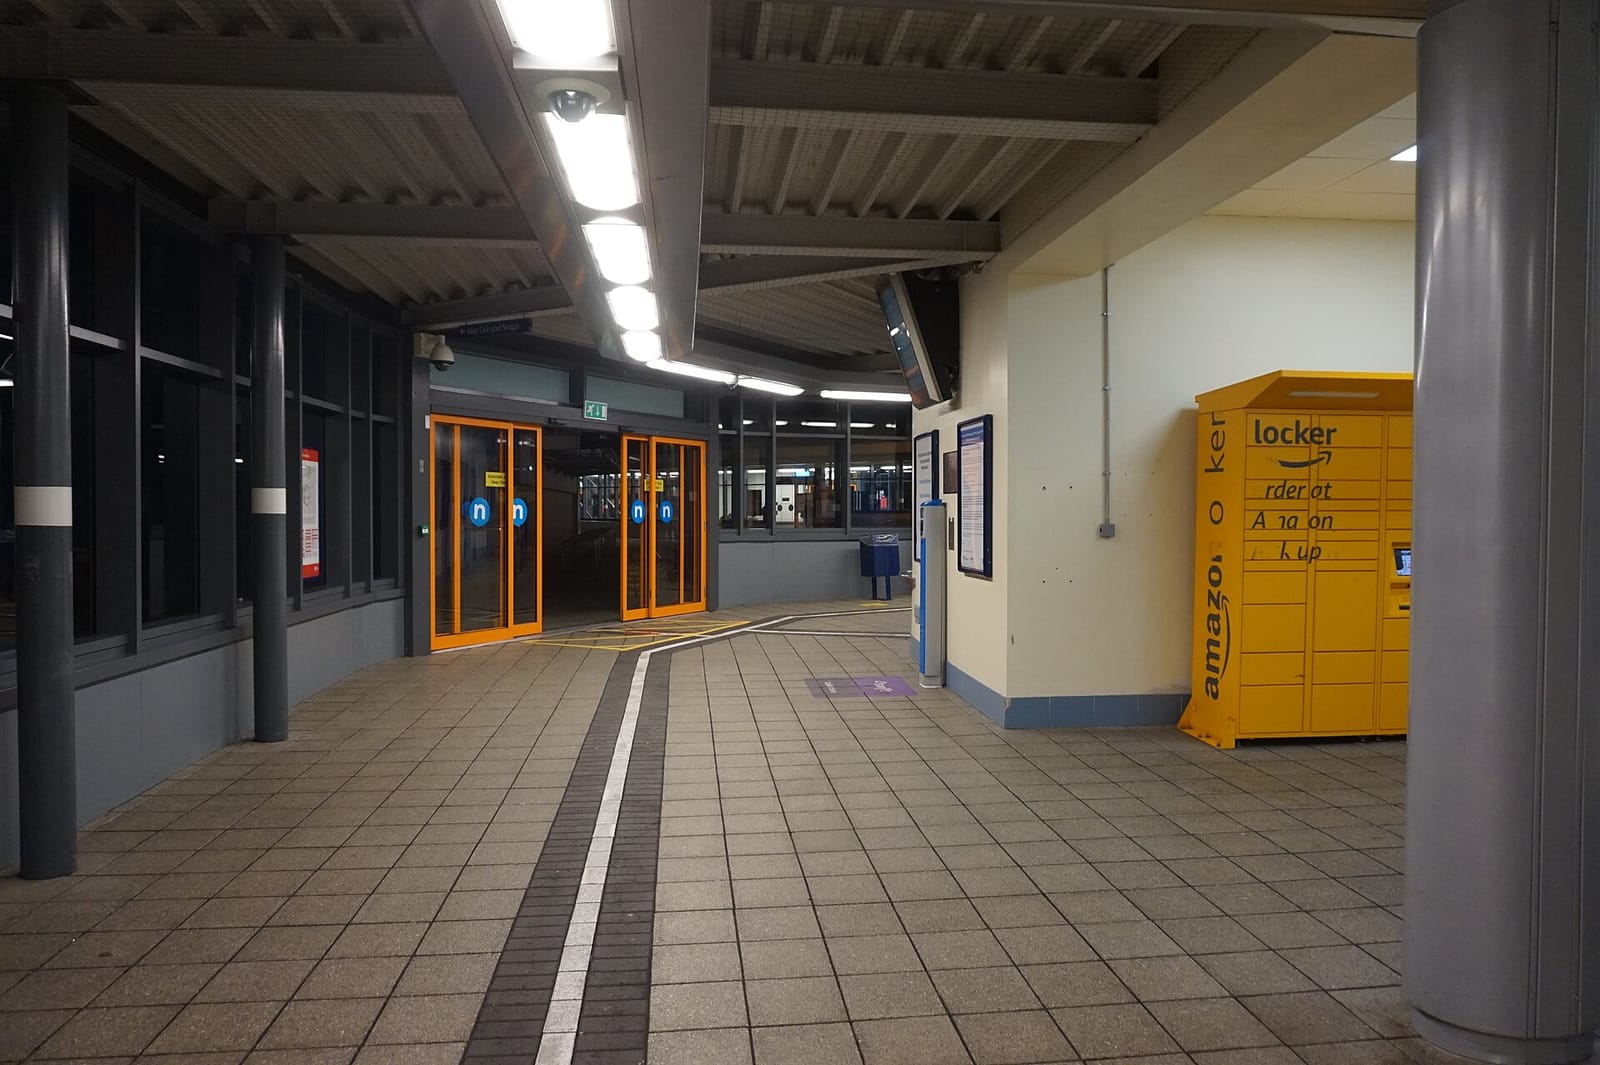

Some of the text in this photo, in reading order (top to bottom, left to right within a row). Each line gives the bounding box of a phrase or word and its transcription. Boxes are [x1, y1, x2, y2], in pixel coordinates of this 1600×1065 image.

[1254, 419, 1337, 445] locker
[1265, 480, 1333, 499] rder at
[473, 503, 486, 520] n
[634, 505, 643, 518] n
[662, 505, 671, 518] n
